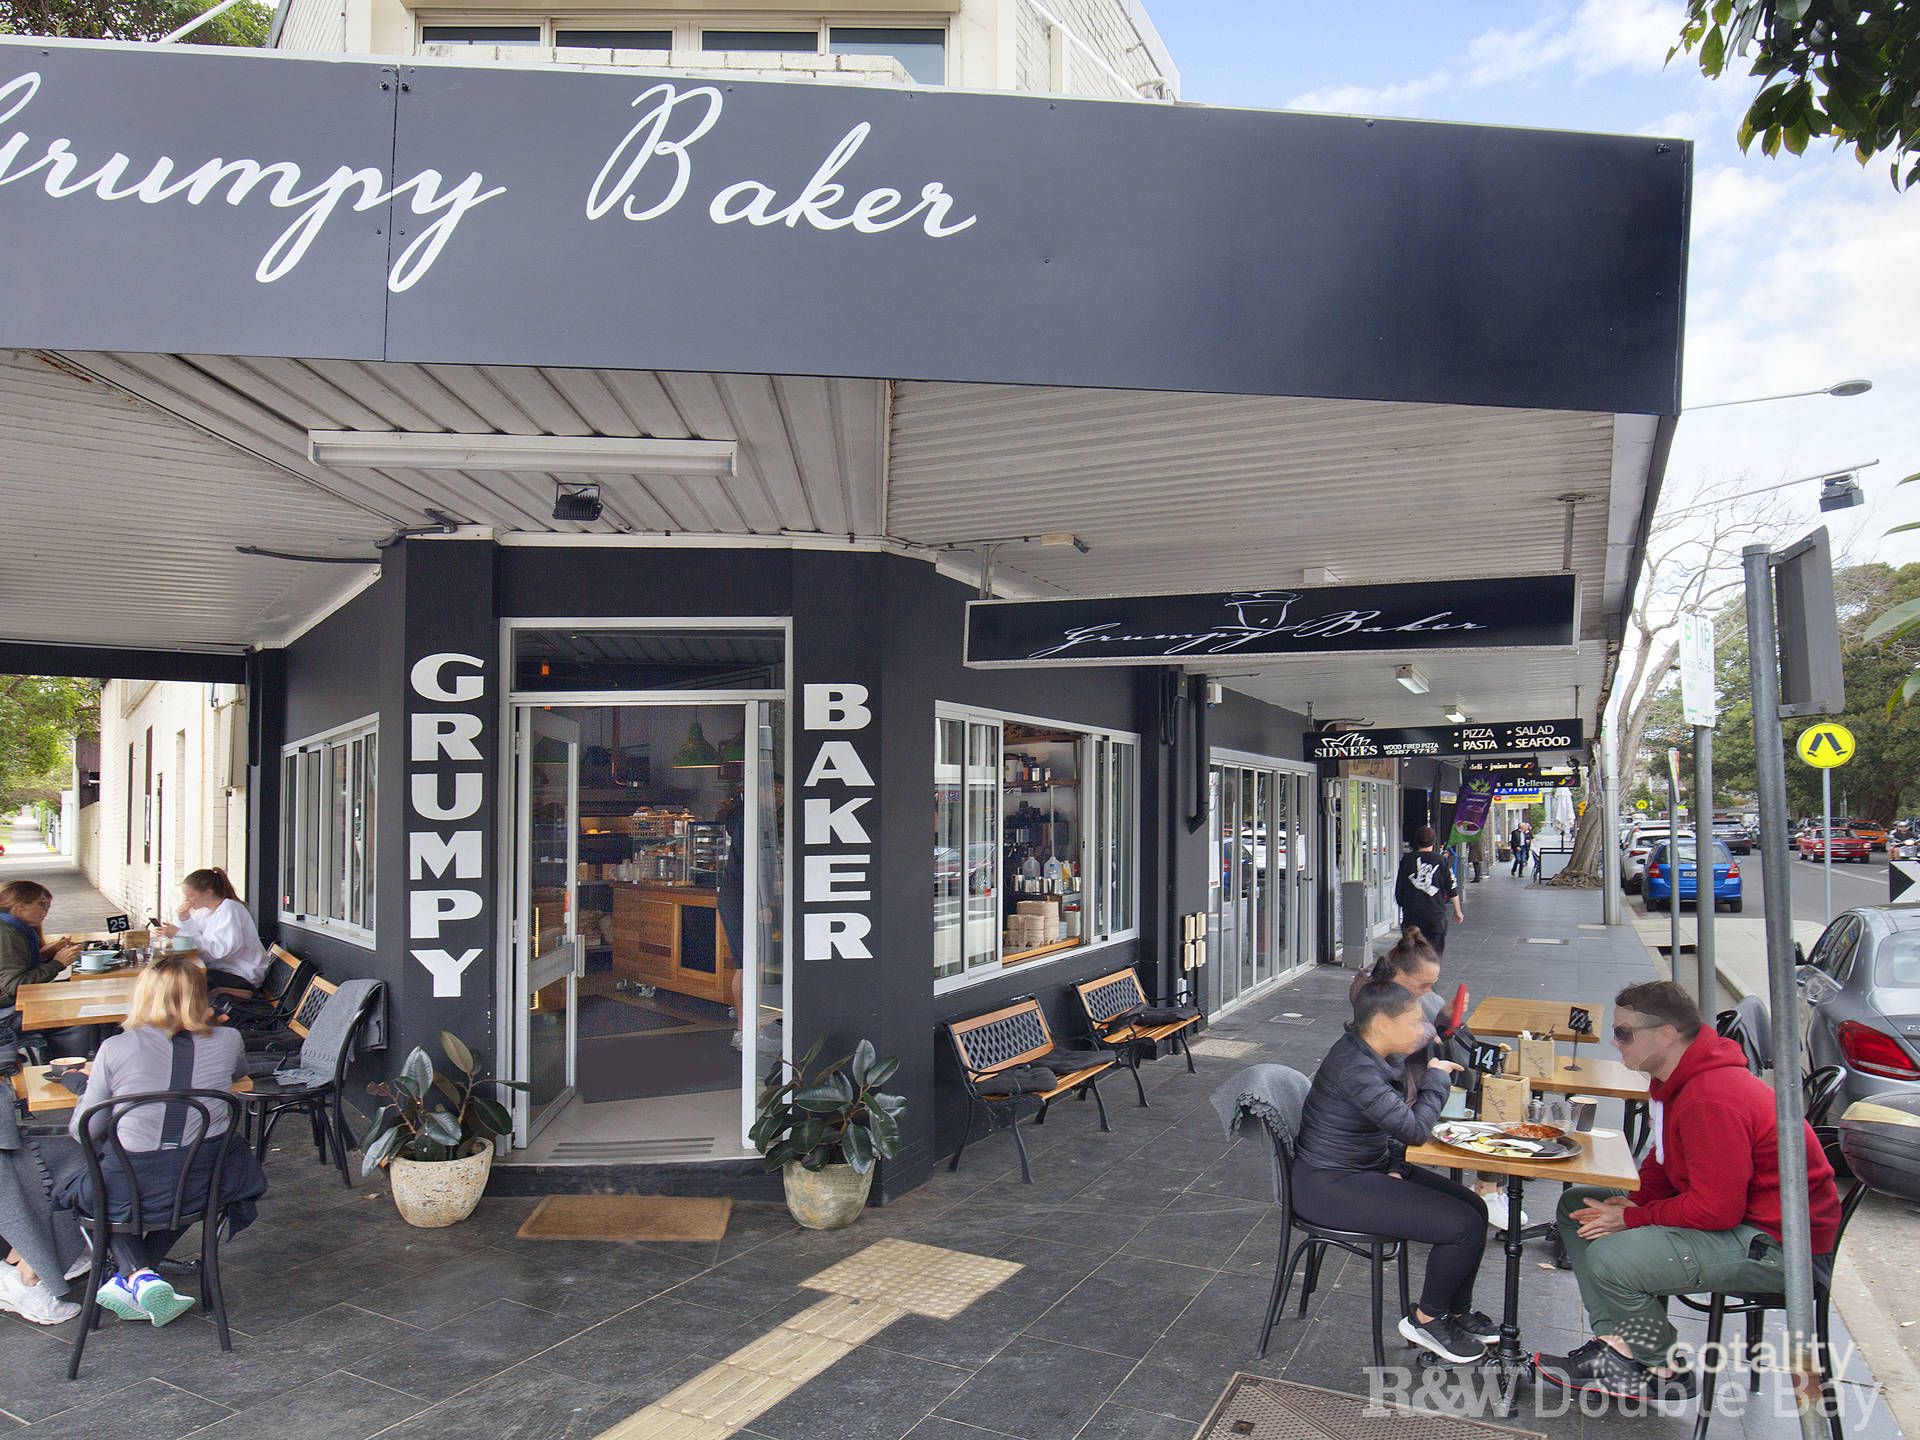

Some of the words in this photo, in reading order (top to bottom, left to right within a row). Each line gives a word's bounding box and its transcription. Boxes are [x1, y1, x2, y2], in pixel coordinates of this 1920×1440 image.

[586, 84, 977, 238] Baker
[1027, 622, 1298, 659] Grumpy
[1293, 610, 1487, 638] Baker
[1463, 728, 1494, 739] PIZZA
[1515, 725, 1554, 737] SALAD
[1462, 739, 1498, 751] PASTA
[1515, 736, 1571, 749] SEAFOOD
[1314, 745, 1378, 758] SIDNEES
[1489, 763, 1508, 772] juice
[1516, 777, 1554, 787] Bellevue
[410, 653, 485, 997] GRUMPY
[803, 683, 875, 960] BAKER
[110, 917, 126, 931] 25
[1473, 1046, 1494, 1069] 14
